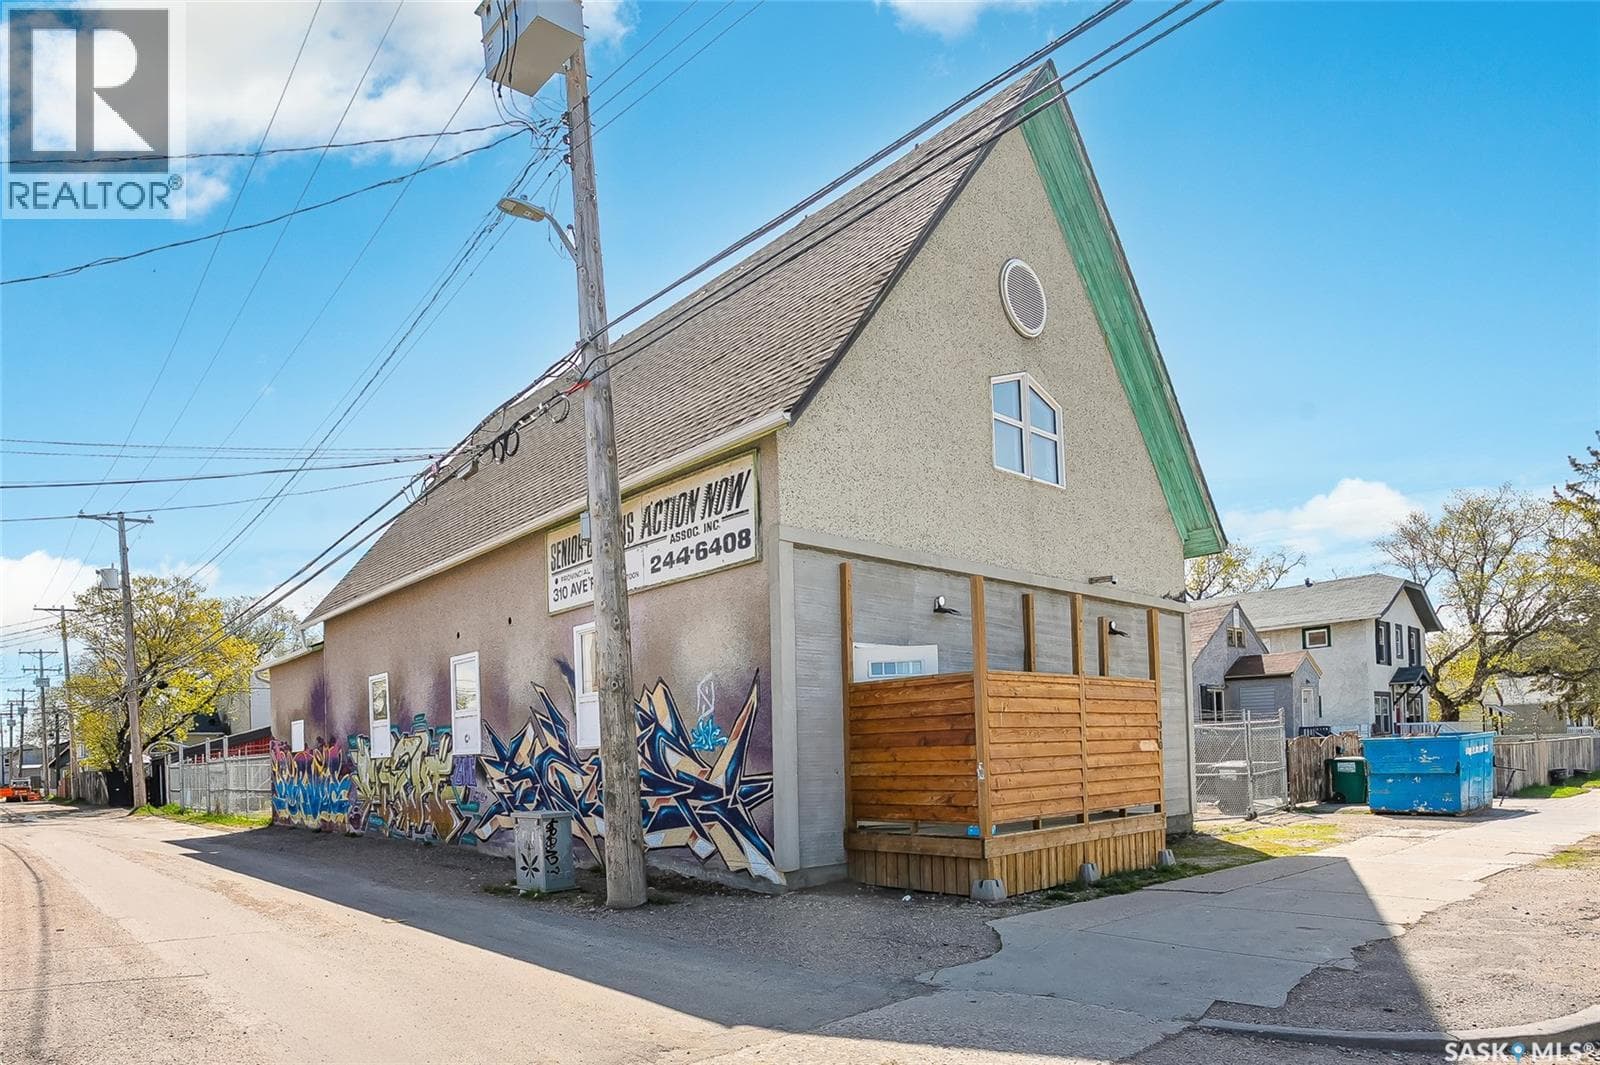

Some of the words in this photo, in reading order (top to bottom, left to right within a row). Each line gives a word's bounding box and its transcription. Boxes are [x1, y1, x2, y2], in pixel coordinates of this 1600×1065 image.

[640, 487, 700, 539] ACTION
[700, 469, 752, 521] NOW
[670, 526, 700, 544] ASSOC.
[703, 519, 720, 534] INC.
[552, 585, 568, 602] 310
[570, 579, 588, 598] AVE
